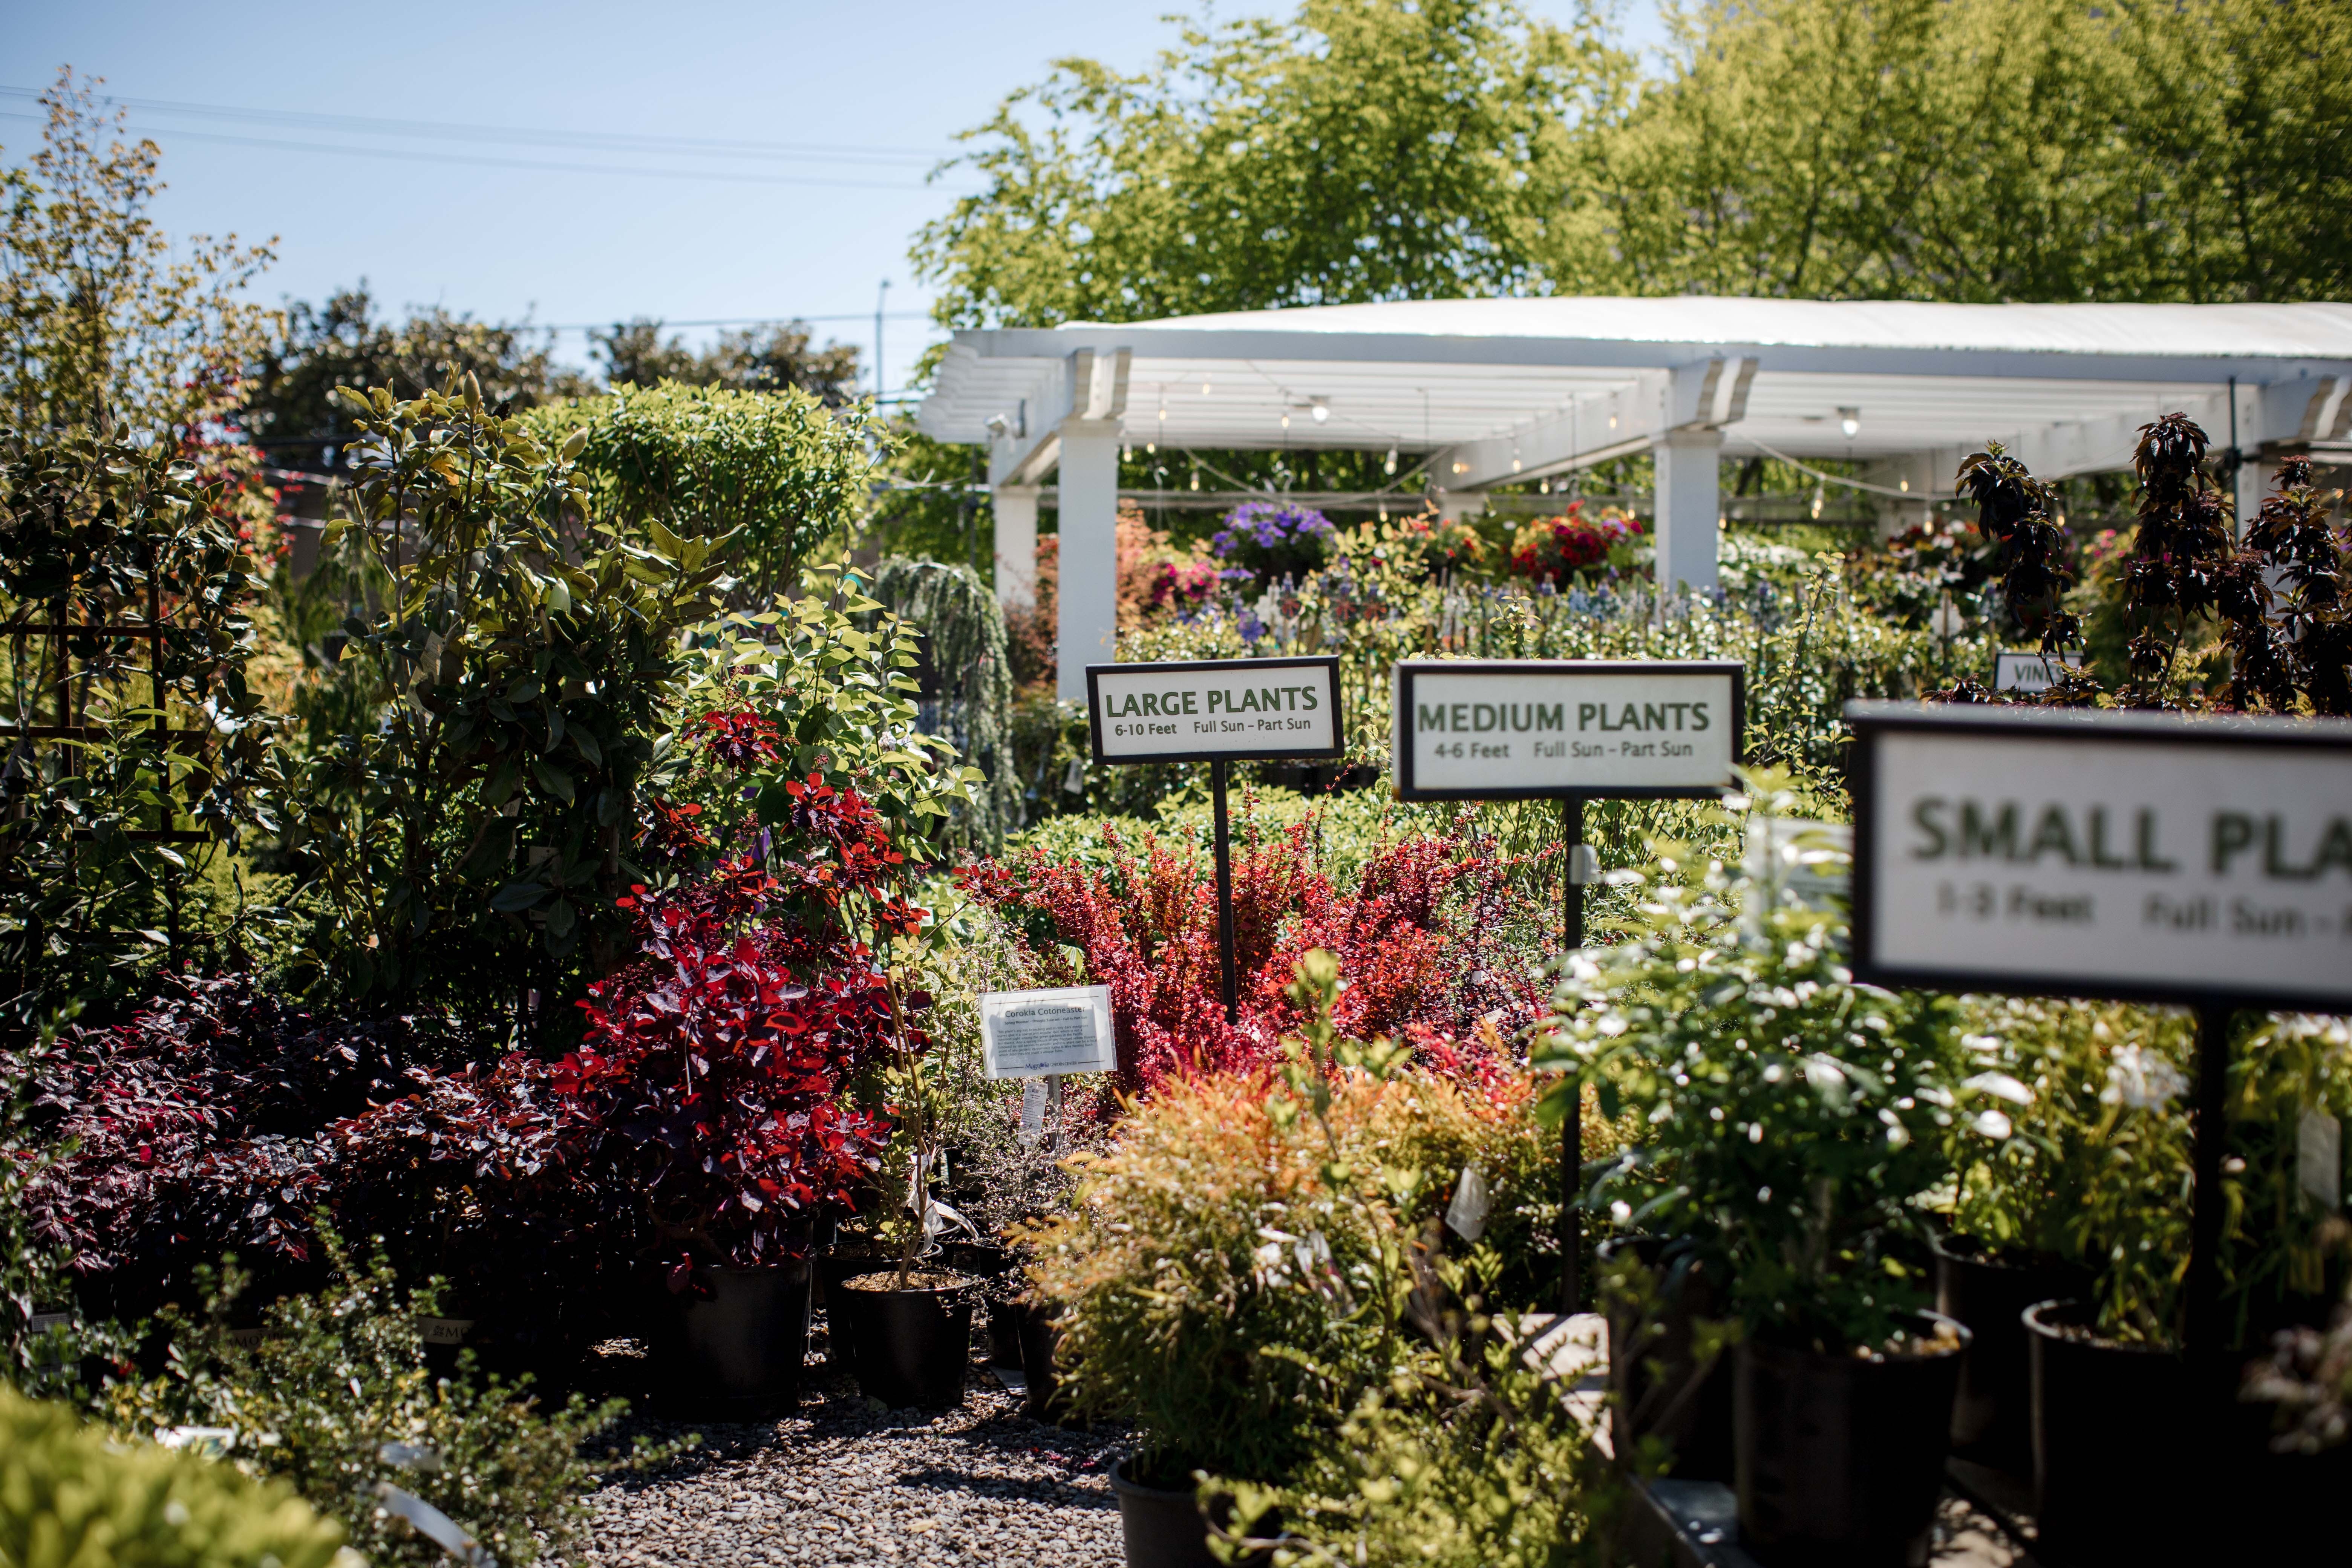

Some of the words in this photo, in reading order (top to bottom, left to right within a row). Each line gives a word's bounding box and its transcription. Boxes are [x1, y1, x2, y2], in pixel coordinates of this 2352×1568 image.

[1106, 692, 1198, 717] LARGE
[1207, 686, 1317, 714] PLANTS
[1115, 723, 1144, 736] 6-10
[1148, 723, 1177, 735] Feet
[1194, 720, 1216, 733] Full
[1221, 720, 1244, 732] Sun
[1257, 719, 1283, 730] Part
[1287, 718, 1311, 730] Sun
[1418, 703, 1563, 732] MEDIUM
[1579, 702, 1710, 731] PLANTS
[1435, 742, 1463, 758] 4-6
[1470, 742, 1510, 758] Feet
[1534, 741, 1564, 757] Full
[1571, 741, 1603, 757] Sun
[1622, 741, 1654, 757] Part
[1660, 741, 1693, 757] Sun
[1909, 795, 2178, 872] SMALL
[1038, 1007, 1086, 1015] Cotoneaster
